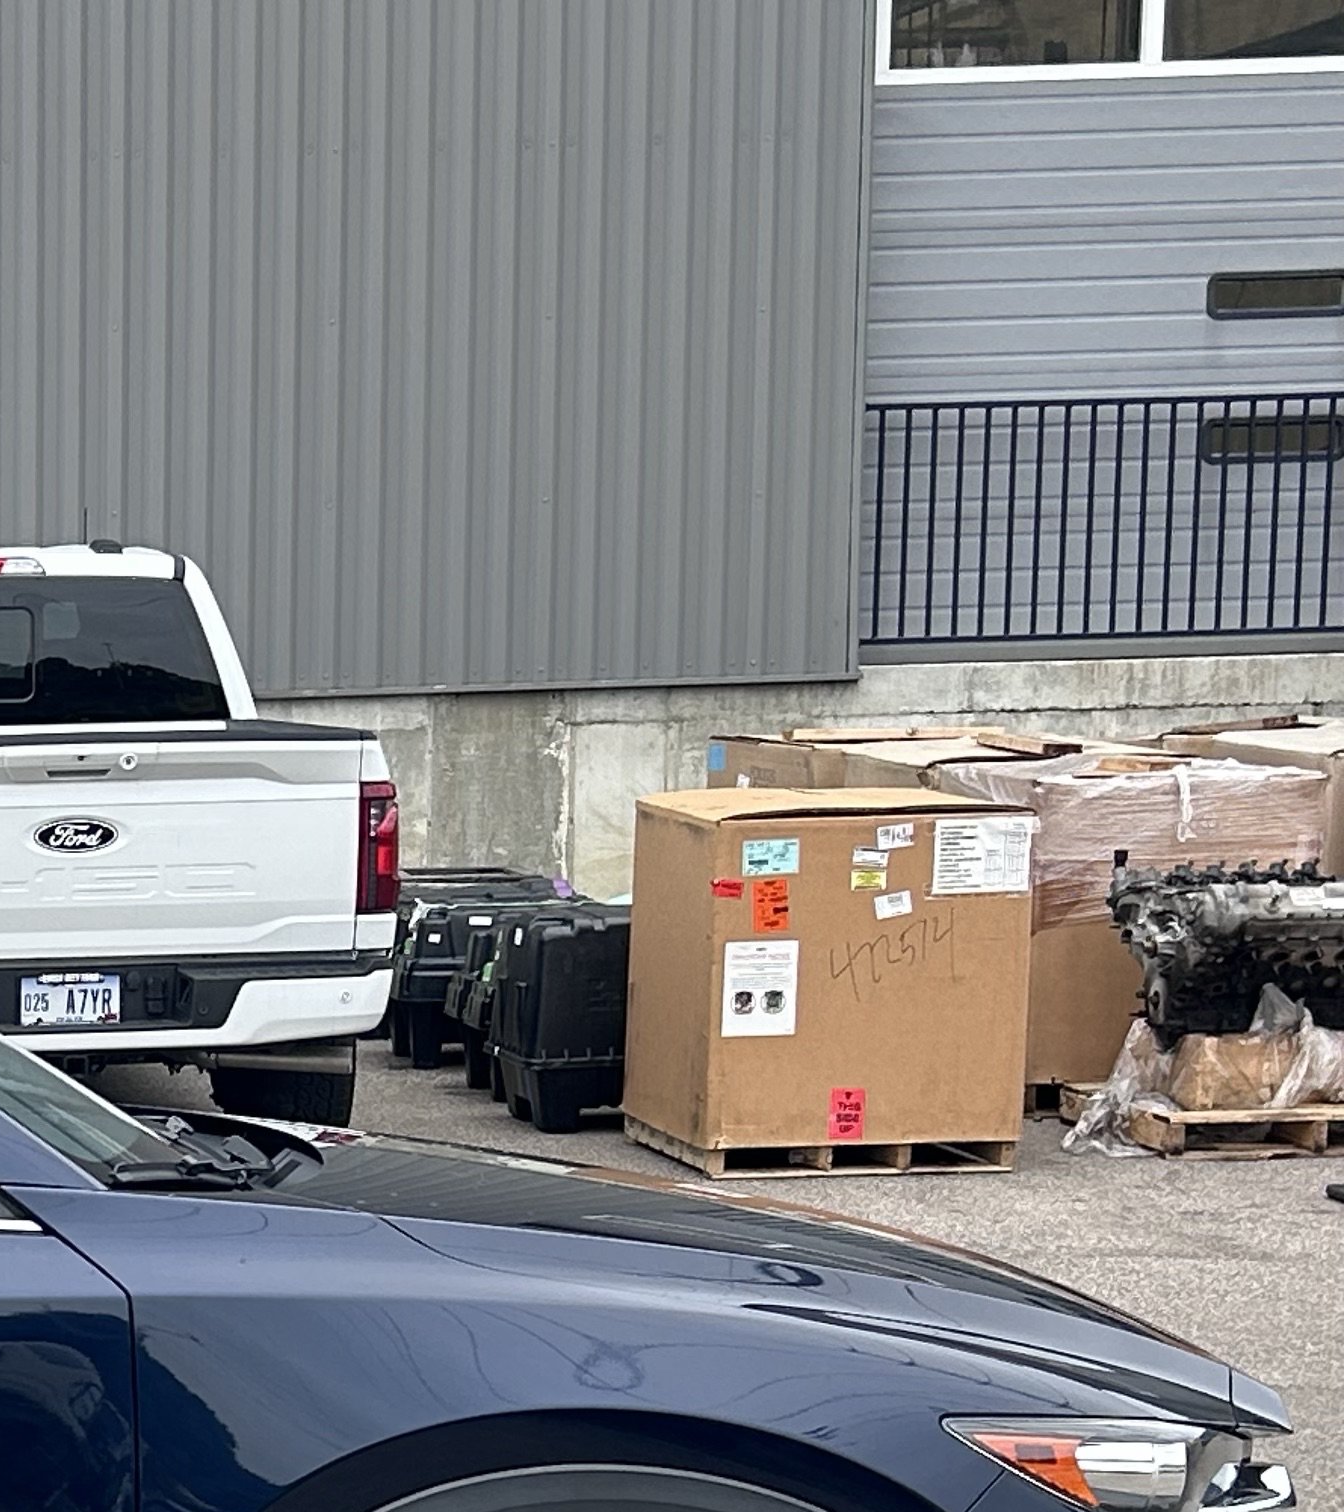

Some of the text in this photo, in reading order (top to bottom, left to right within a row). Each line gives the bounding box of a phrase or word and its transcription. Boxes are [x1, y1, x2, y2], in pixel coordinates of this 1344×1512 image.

[49, 824, 102, 848] Ford
[24, 987, 113, 1015] 025 A7YR
